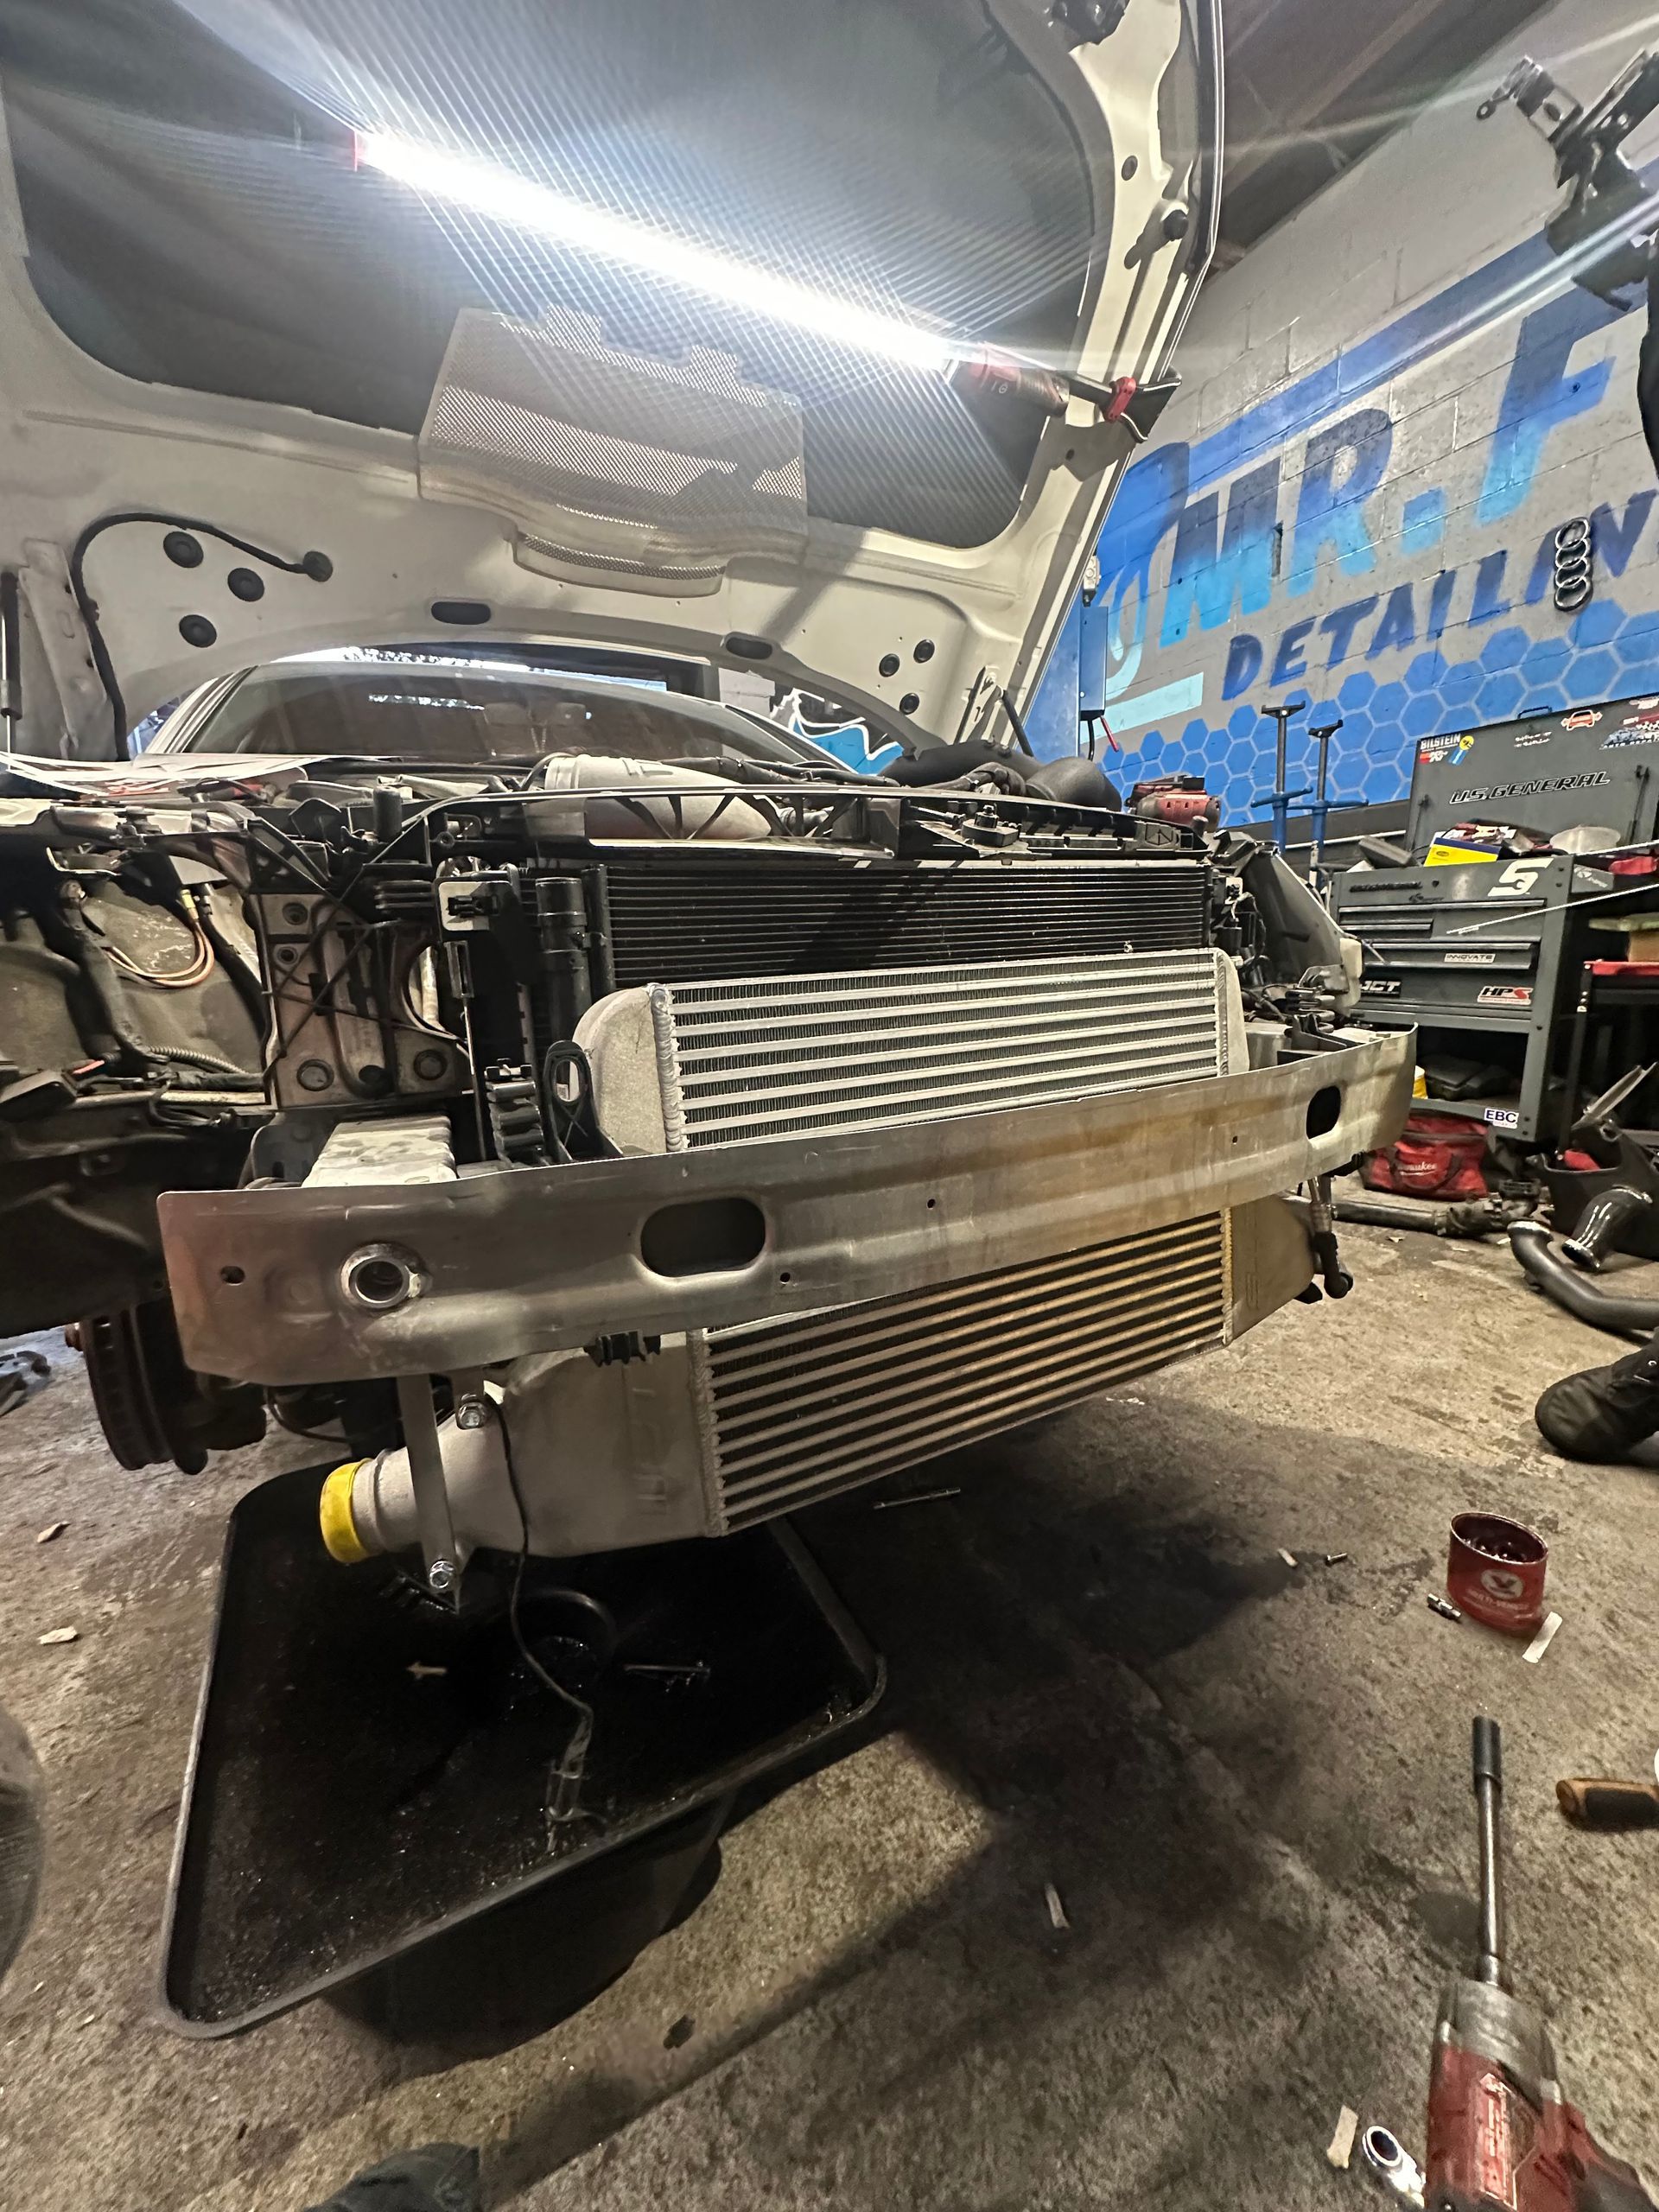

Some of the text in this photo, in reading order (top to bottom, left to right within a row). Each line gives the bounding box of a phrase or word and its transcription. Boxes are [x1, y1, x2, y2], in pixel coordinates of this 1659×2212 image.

[1222, 488, 1659, 701] DETAILIN
[1420, 733, 1461, 750] BILSTEIN
[1489, 771, 1611, 799] GENERAL
[1481, 987, 1531, 1000] HPS
[1485, 1109, 1517, 1123] EBC
